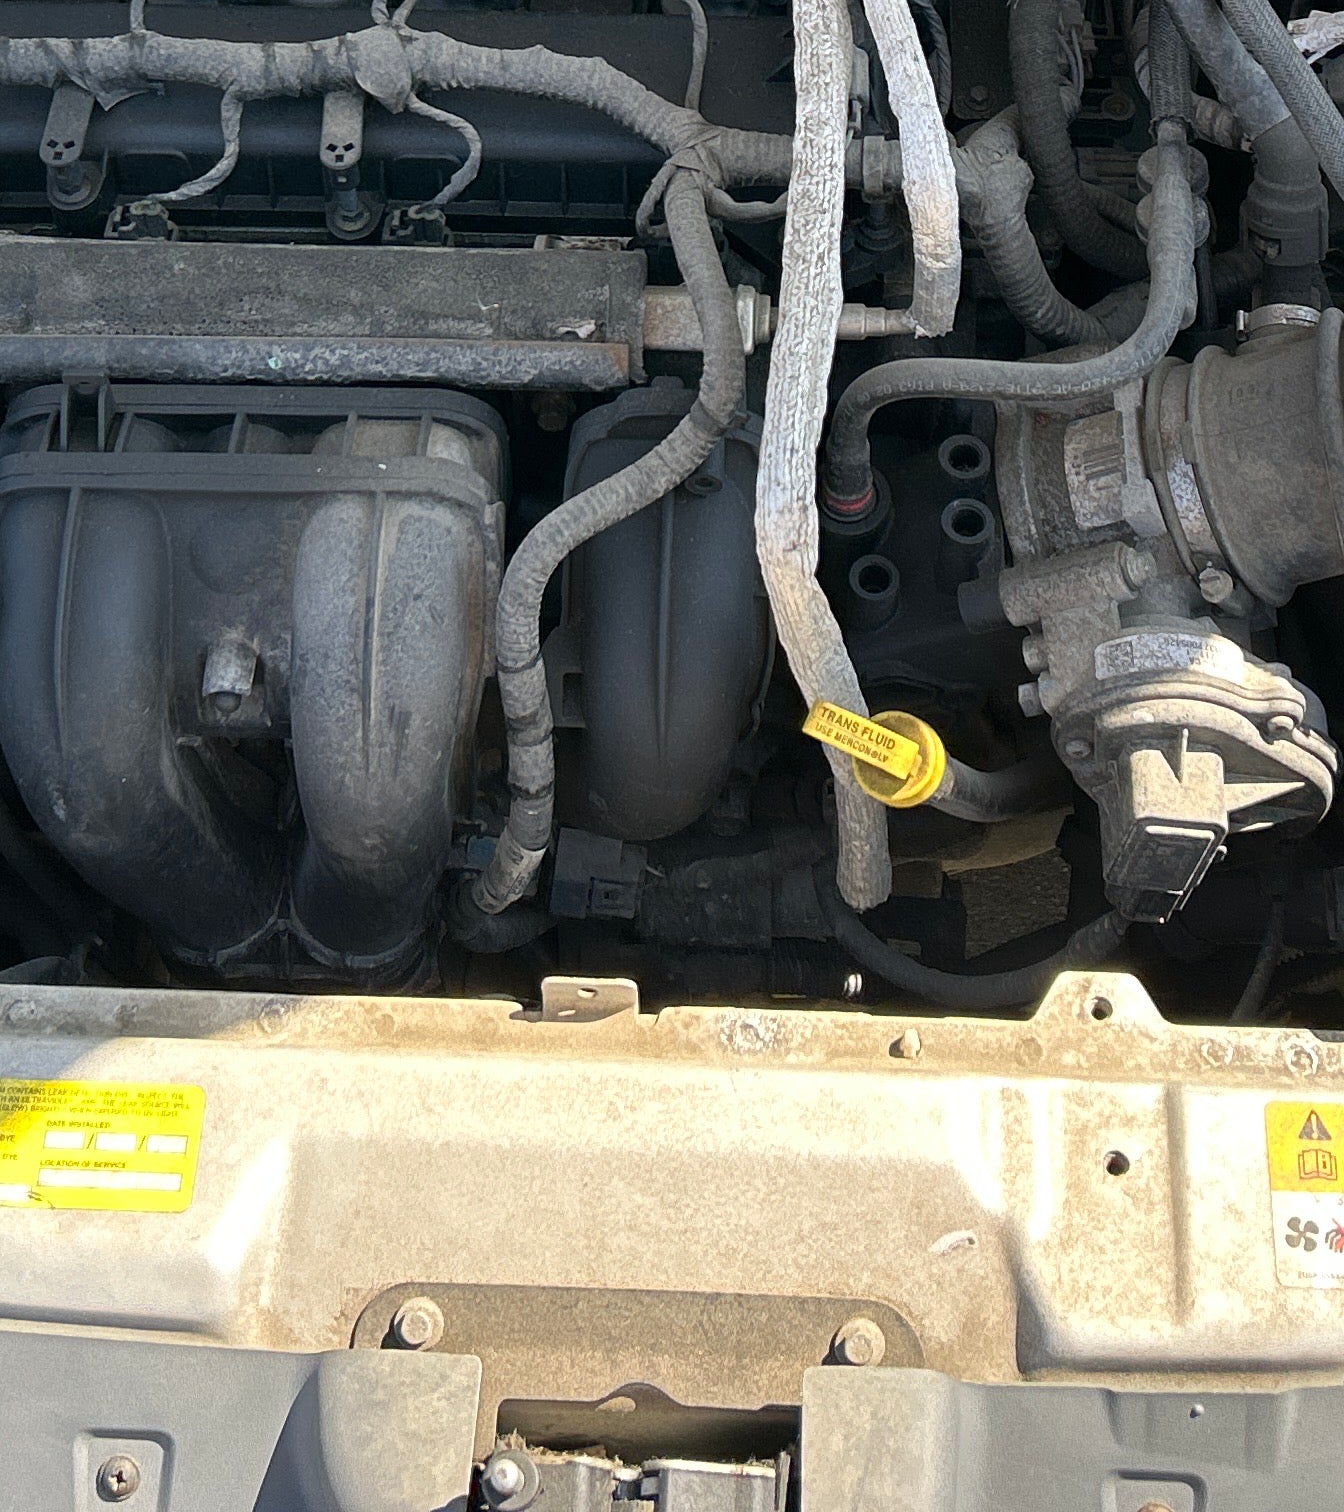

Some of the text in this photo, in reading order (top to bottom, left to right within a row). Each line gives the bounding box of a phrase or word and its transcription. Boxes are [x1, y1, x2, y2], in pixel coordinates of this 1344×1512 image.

[815, 722, 833, 737] USE
[820, 706, 896, 750] TRANS FLUID
[7, 1087, 47, 1095] CONTAINS
[46, 1120, 111, 1128] DATE INSTALLED
[0, 1134, 16, 1143] DYE
[40, 1160, 81, 1168] LOCATION
